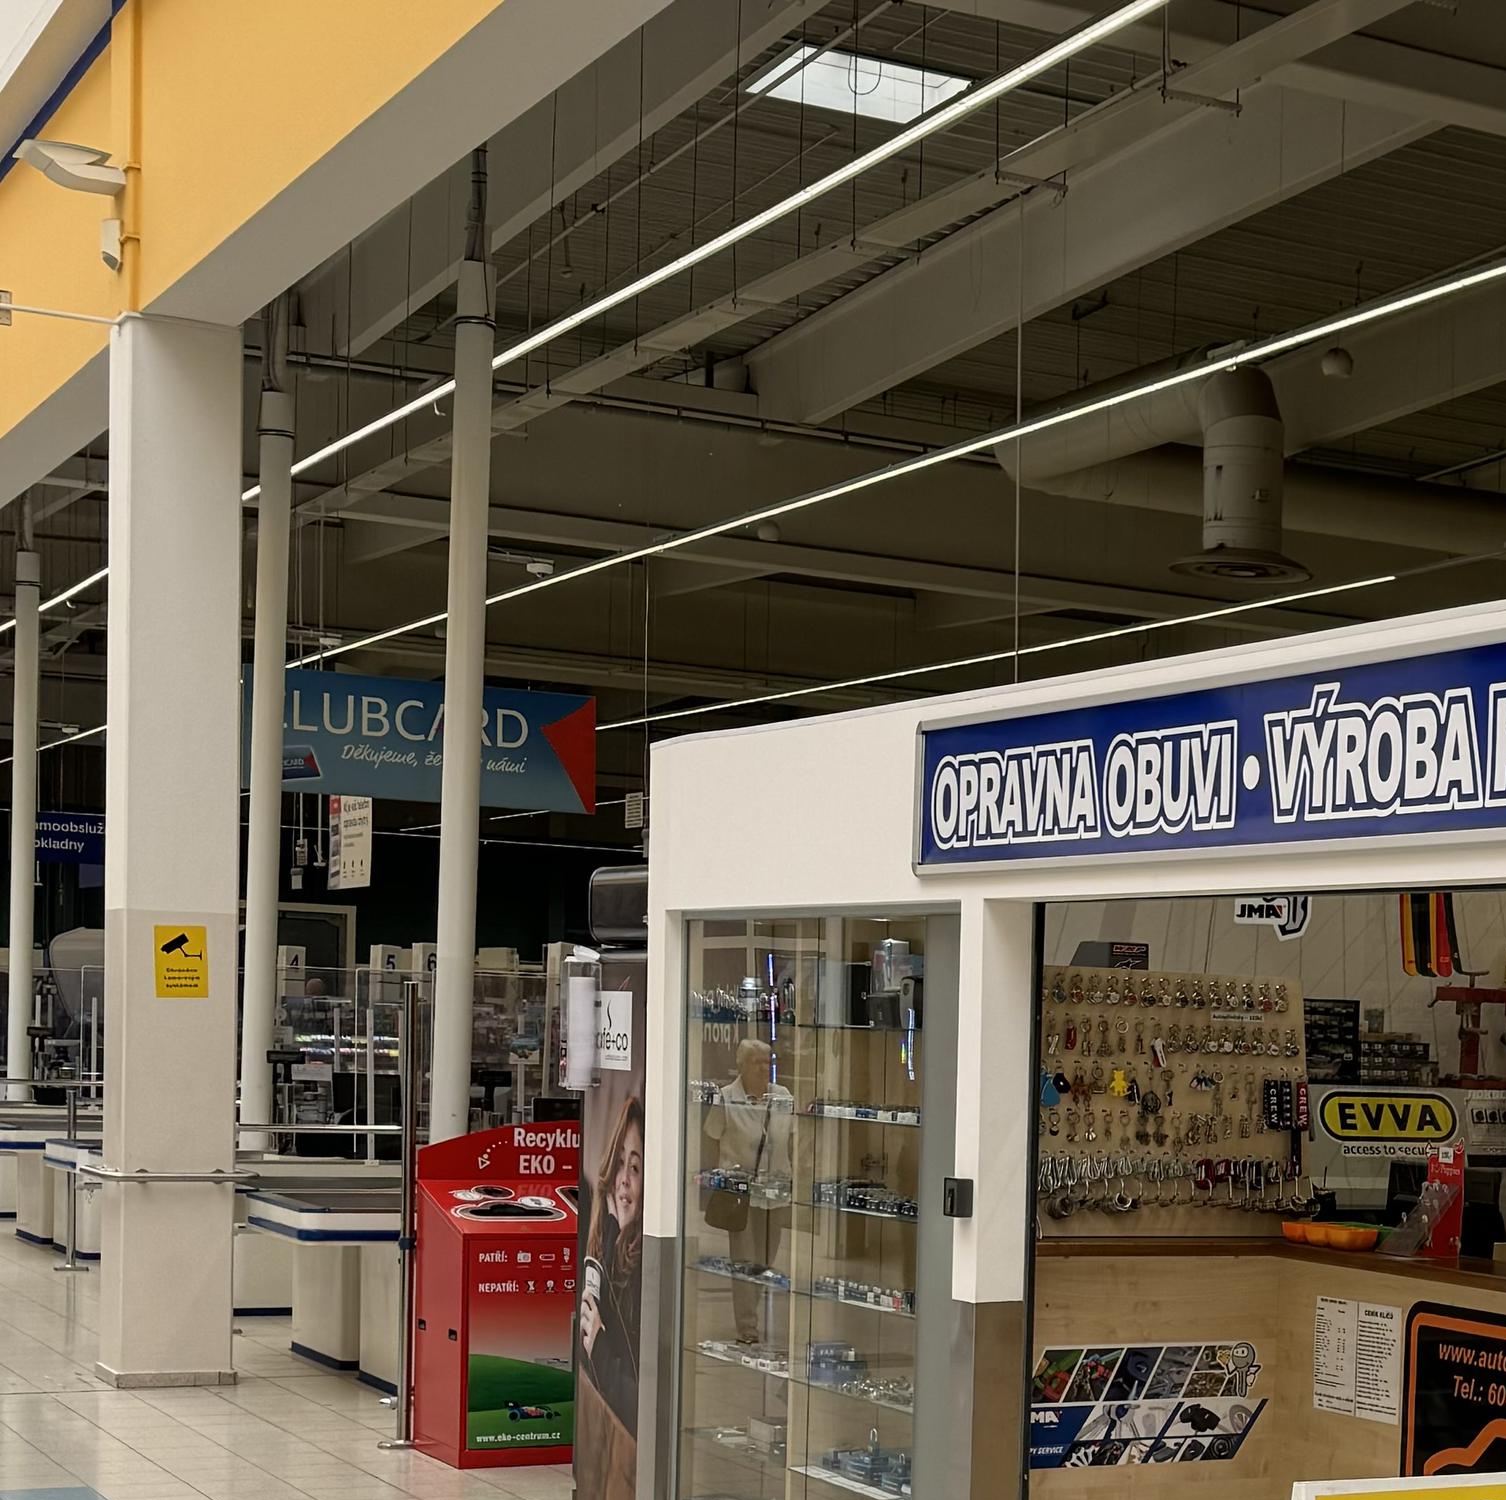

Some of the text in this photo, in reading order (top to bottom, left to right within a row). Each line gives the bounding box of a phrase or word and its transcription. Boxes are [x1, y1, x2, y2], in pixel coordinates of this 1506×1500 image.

[341, 744, 418, 768] Děkujeme,
[487, 756, 527, 773] námi
[931, 739, 1100, 850] OPRAVNA
[1104, 720, 1237, 838] OBUVI
[1264, 682, 1481, 824] VÝROBA
[34, 838, 84, 853] okladny
[1236, 903, 1284, 919] JMA
[290, 954, 299, 968] 4
[386, 954, 396, 972] 5
[427, 953, 437, 972] 6
[1269, 1088, 1279, 1124] CREW
[1299, 1087, 1308, 1127] CREW
[1338, 1102, 1443, 1132] EVVA
[514, 1127, 580, 1151] Recyklu
[1343, 1144, 1380, 1155] access
[1384, 1144, 1397, 1155] to
[1399, 1145, 1426, 1156] secu
[519, 1155, 556, 1175] EKO
[479, 1250, 508, 1263] PATŘÍ:
[478, 1279, 519, 1293] NEPATŘÍ:
[1453, 1375, 1484, 1402] Tel.:
[1030, 1411, 1060, 1424] MA
[476, 1431, 561, 1443] www.eko-centrum.cz
[1038, 1446, 1064, 1455] SERVICE
